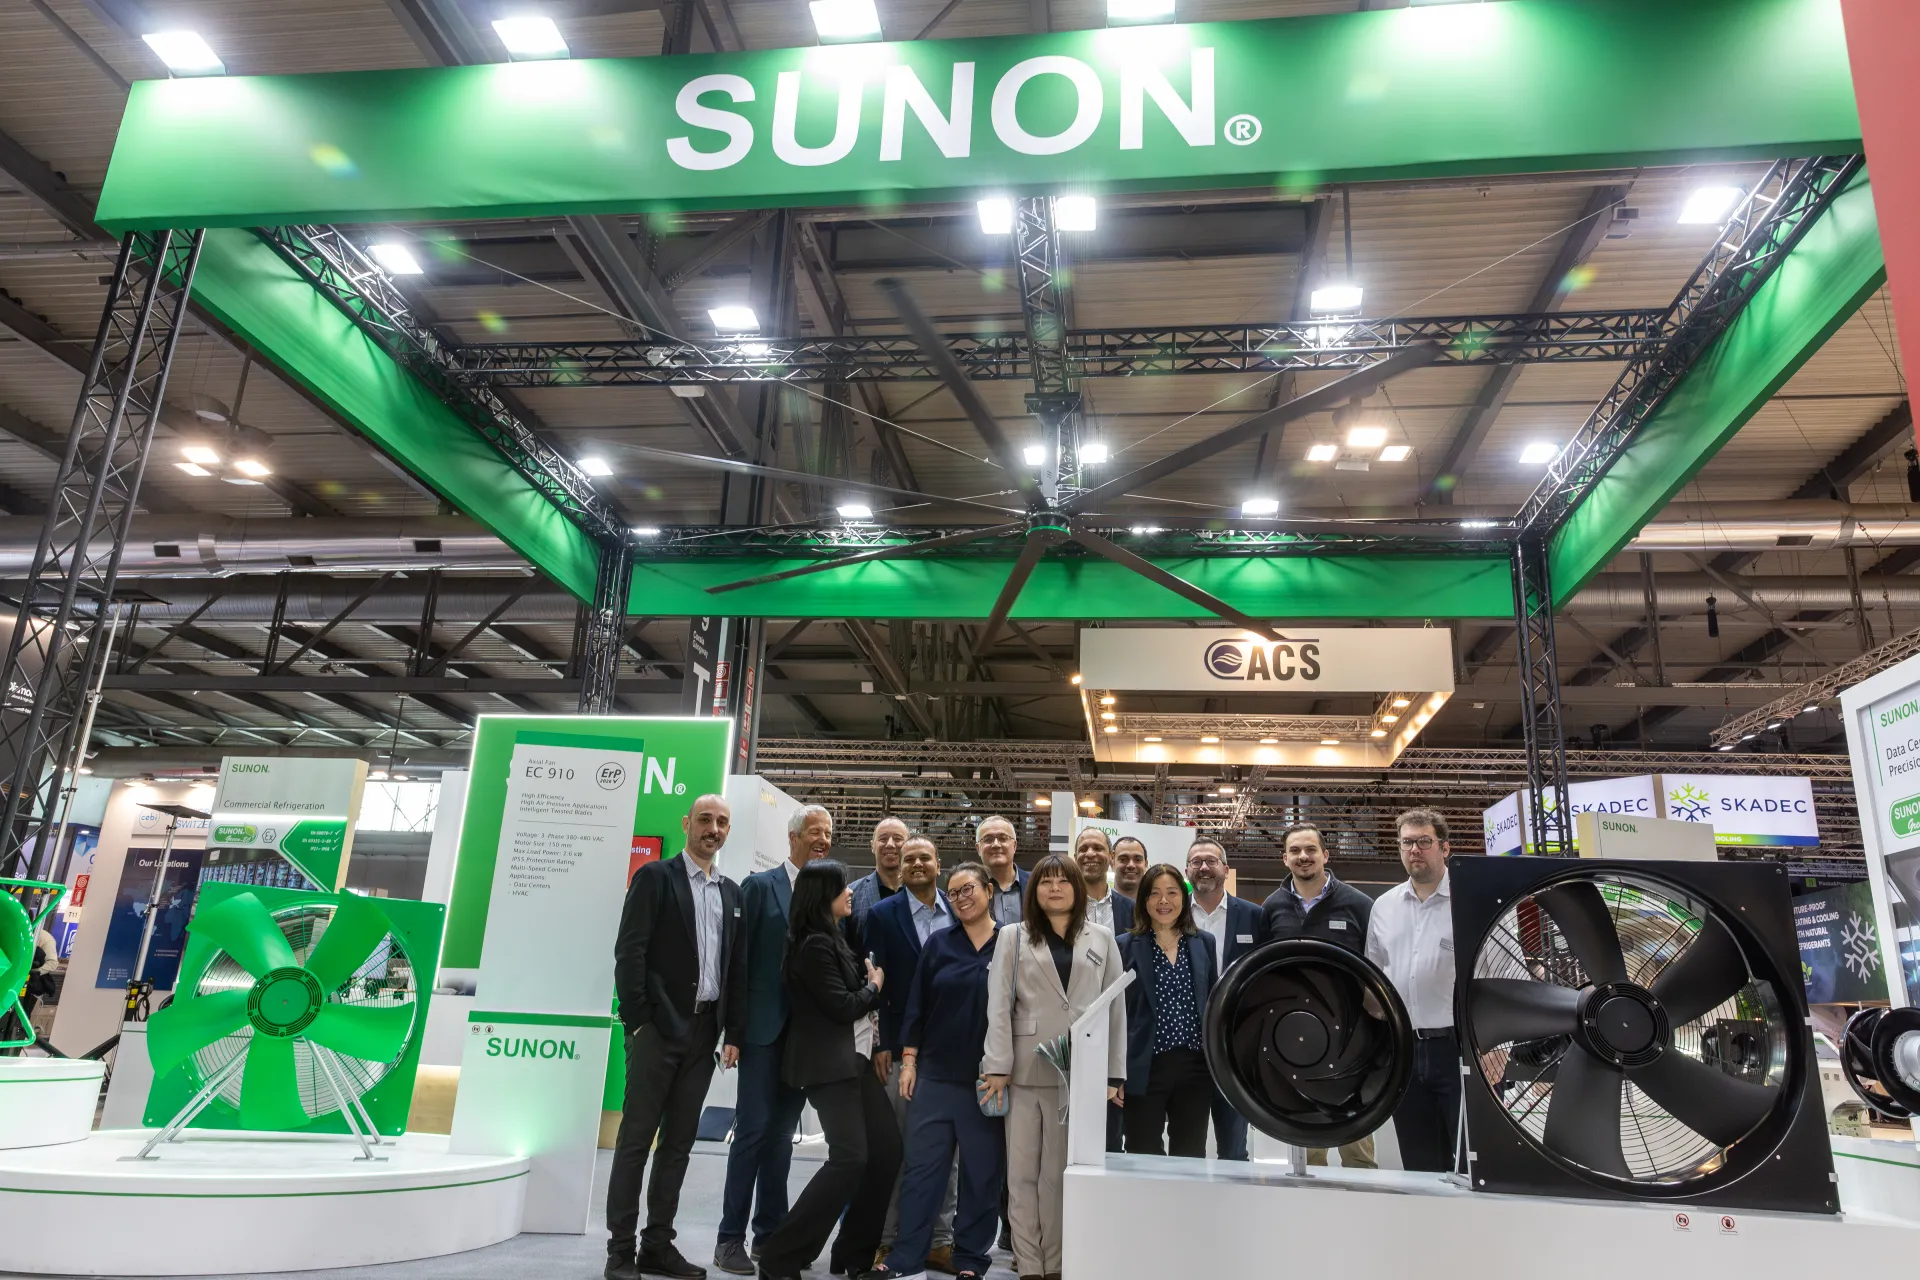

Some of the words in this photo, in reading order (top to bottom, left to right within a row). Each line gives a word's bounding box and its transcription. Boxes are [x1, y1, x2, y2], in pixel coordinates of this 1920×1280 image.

[1246, 643, 1321, 681] ACS
[1886, 744, 1906, 760] Data
[1907, 738, 1920, 753] Ce
[525, 766, 543, 778] EC
[548, 767, 575, 780] 910
[601, 768, 622, 779] ErP
[537, 793, 565, 801] Efficiency
[224, 800, 271, 809] Commercial
[273, 801, 325, 811] Refrigeration
[519, 806, 549, 814] Intelligent
[551, 807, 572, 815] Twisted
[574, 808, 593, 816] Blades
[572, 802, 608, 810] Applications
[1721, 797, 1807, 814] SKADEC
[1894, 800, 1920, 820] SUNO
[176, 819, 211, 828] SWITZE
[1496, 813, 1519, 835] SKADEC
[1714, 835, 1743, 843] OOLING
[631, 846, 651, 856] sting
[138, 859, 153, 867] Our
[154, 859, 189, 868] Loations
[510, 864, 546, 872] Multi-Speed
[1795, 918, 1812, 927] EATING
[1816, 911, 1839, 923] COOLING
[1805, 926, 1828, 938] NATURAL
[1798, 938, 1831, 951] EFRIGERANTS
